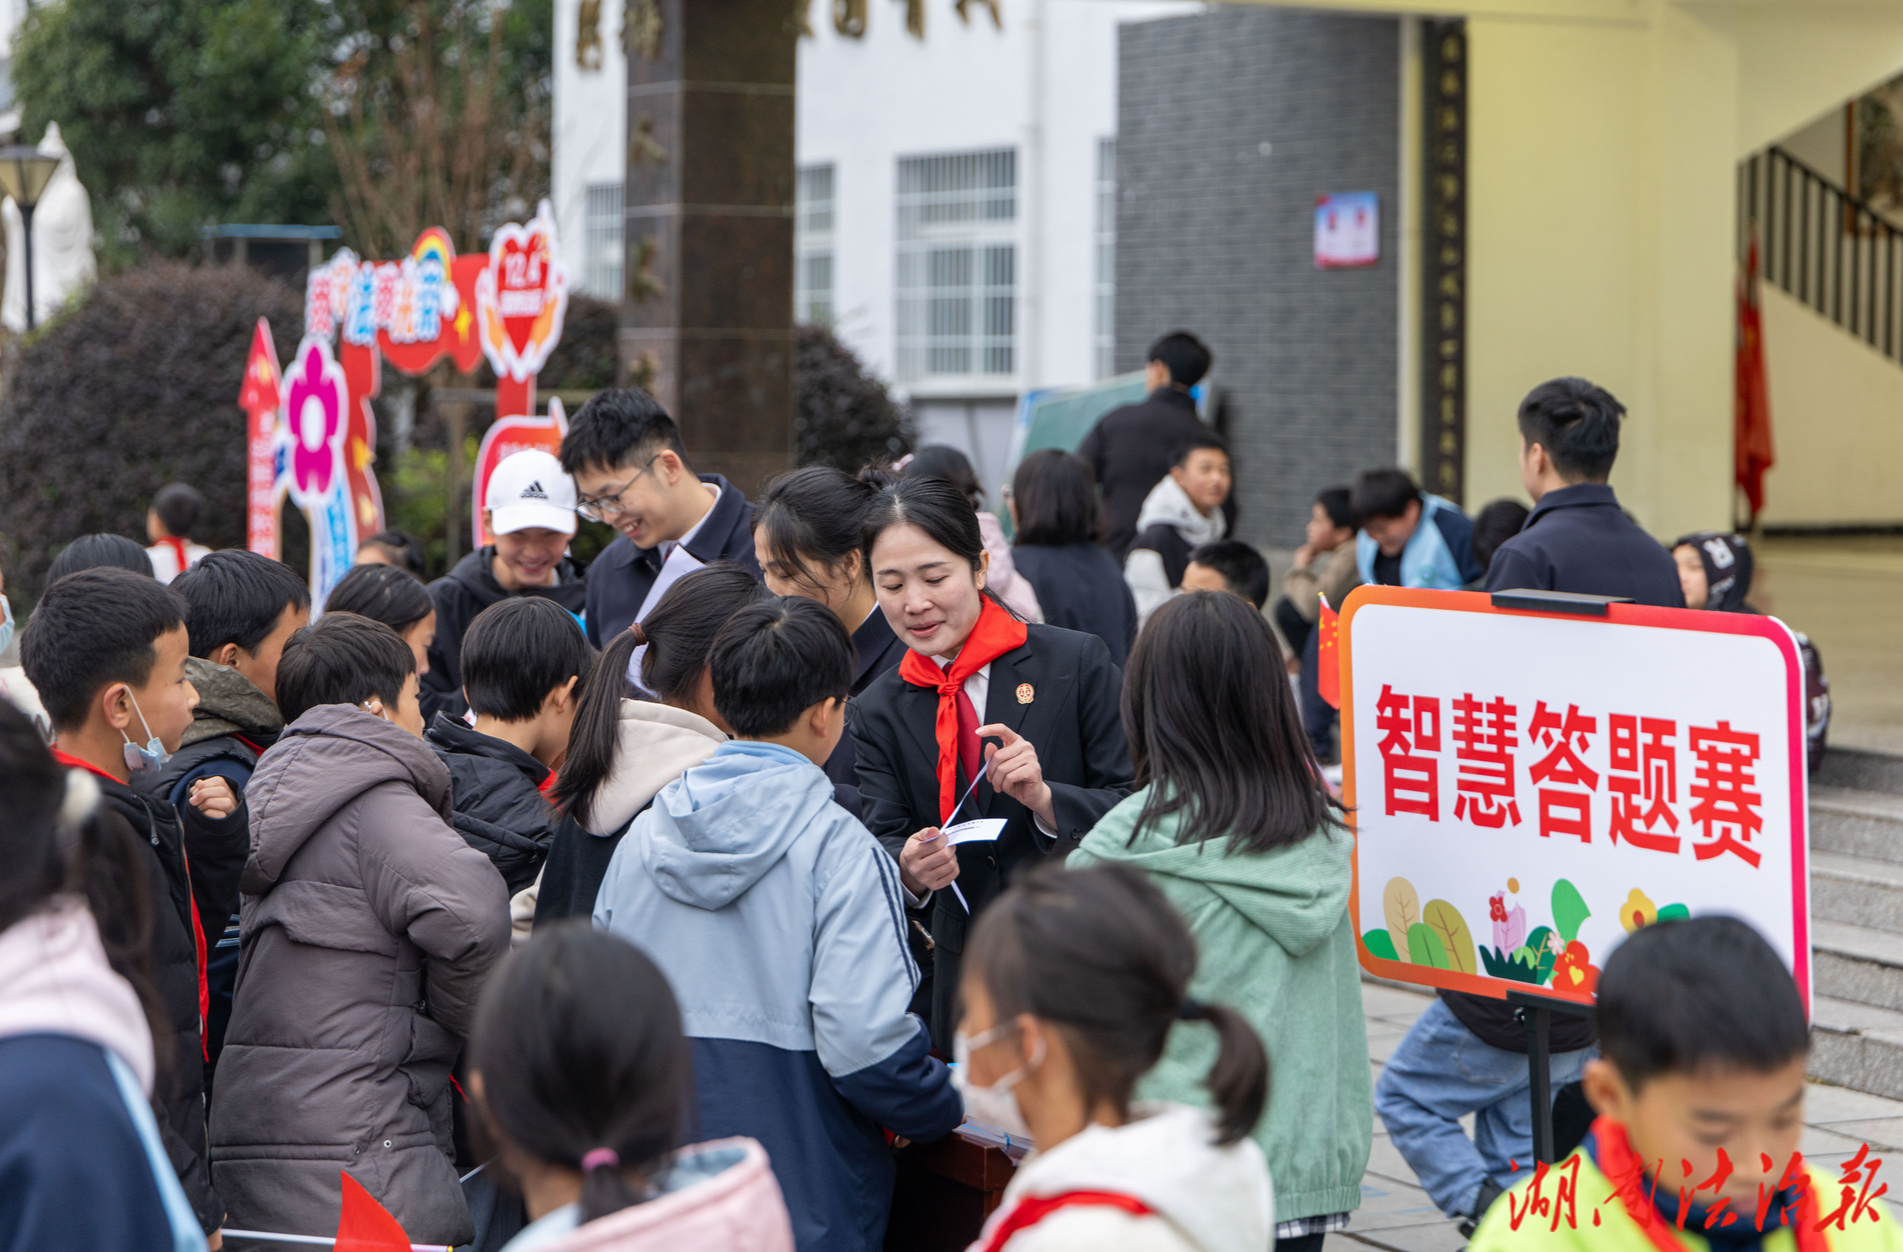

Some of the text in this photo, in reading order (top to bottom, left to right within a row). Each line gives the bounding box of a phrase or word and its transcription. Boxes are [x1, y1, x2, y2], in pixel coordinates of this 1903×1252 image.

[1375, 683, 1764, 869] 智慧答题赛
